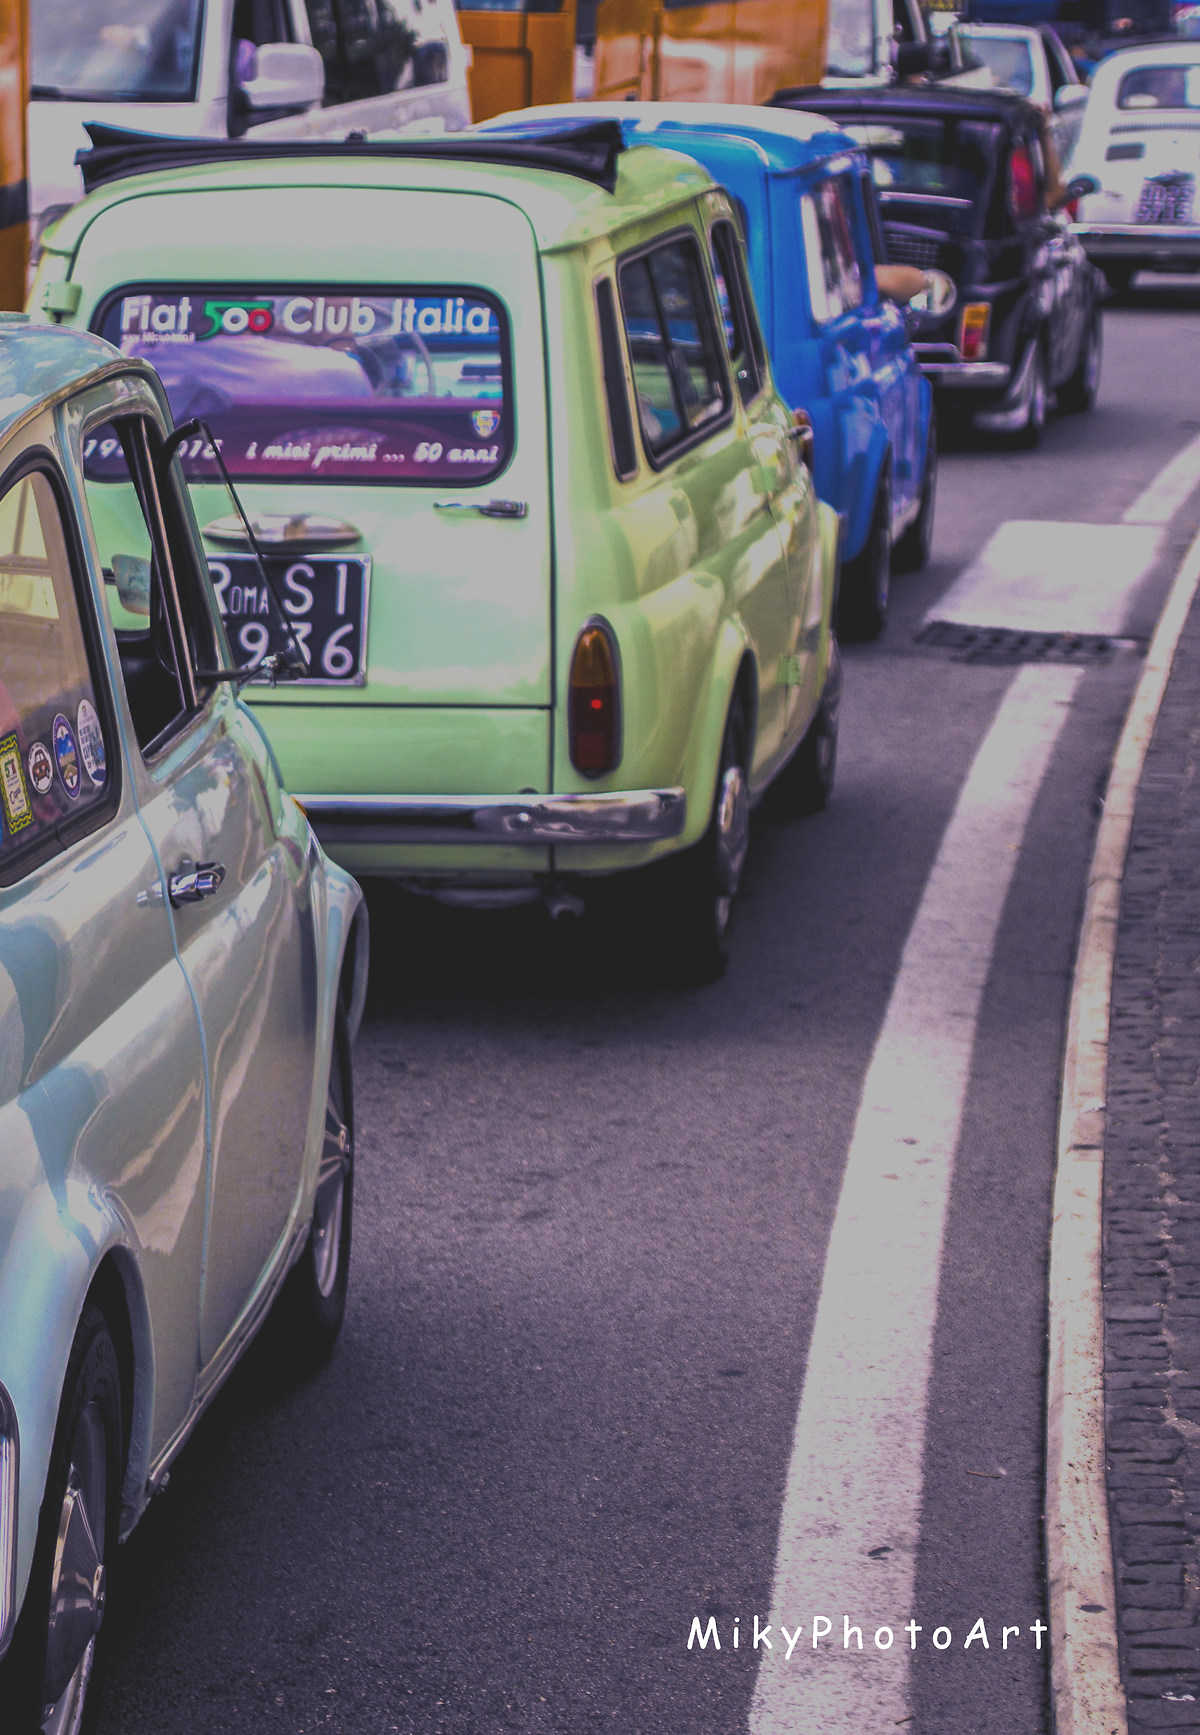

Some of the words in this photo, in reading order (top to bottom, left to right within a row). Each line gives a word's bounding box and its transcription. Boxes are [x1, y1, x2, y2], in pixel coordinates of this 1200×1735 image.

[121, 295, 192, 332] Fiat
[197, 300, 275, 341] 500
[283, 297, 376, 333] Club
[391, 297, 490, 334] Italia
[311, 443, 378, 469] primi
[447, 445, 499, 463] anni
